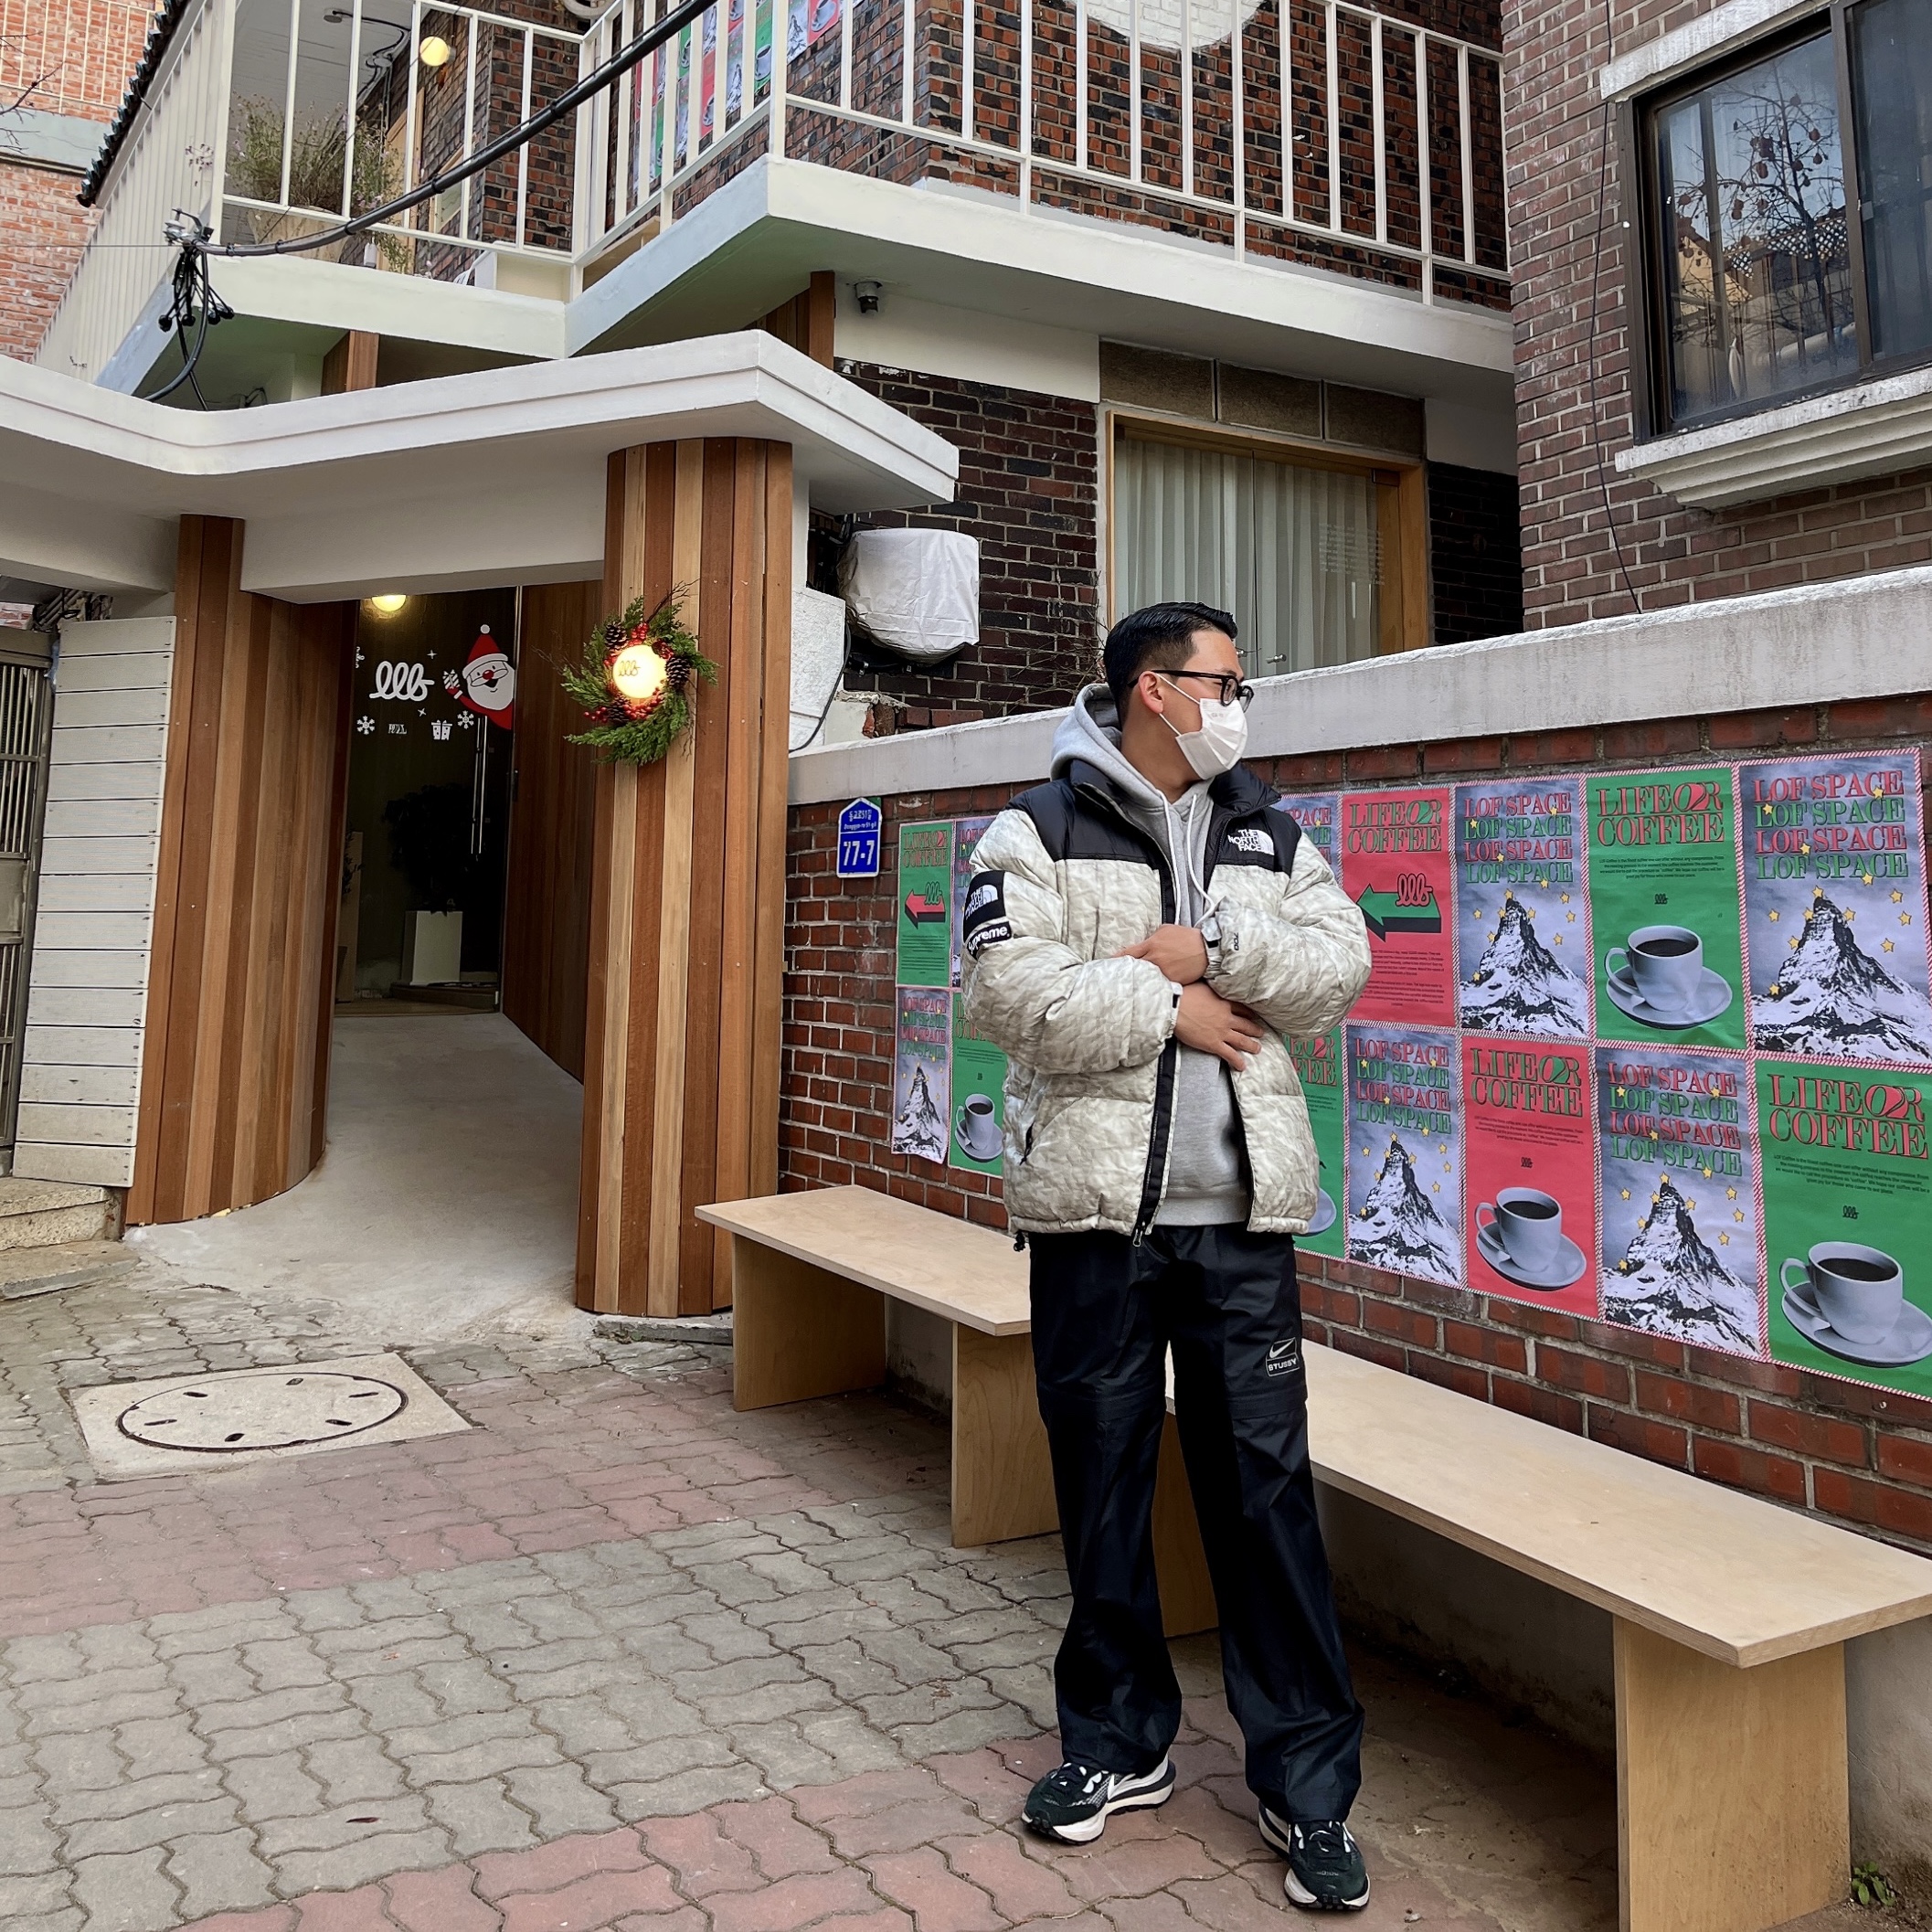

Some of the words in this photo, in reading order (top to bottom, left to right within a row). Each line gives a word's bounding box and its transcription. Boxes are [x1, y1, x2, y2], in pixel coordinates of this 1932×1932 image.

[1753, 777, 1806, 802] LOF
[1810, 770, 1904, 800] SPACE
[1284, 807, 1332, 826] PACE
[1464, 797, 1503, 818] LOF
[1506, 792, 1572, 816] SPACE
[1754, 801, 1808, 828] LOF
[1811, 798, 1905, 825] SPACE
[1347, 825, 1442, 854] COFFEE
[1463, 819, 1502, 840] LOF
[1505, 815, 1572, 838] SPACE
[1598, 812, 1725, 846] COFFEE
[1755, 829, 1809, 854] LOF
[1813, 825, 1906, 852] SPACE
[844, 840, 875, 865] 77-7
[1238, 844, 1261, 852] FACE
[1463, 840, 1503, 862] LOF
[1505, 838, 1573, 860] SPACE
[1464, 863, 1503, 884] LOF
[1506, 862, 1573, 883] SPACE
[1756, 855, 1810, 879] LOF
[1814, 853, 1908, 879] SPACE
[1355, 1037, 1388, 1060] LOF
[1391, 1042, 1449, 1067] SPACE
[1356, 1059, 1389, 1081] LOF
[1392, 1063, 1449, 1089] SPACE
[1608, 1062, 1653, 1088] LOF
[1657, 1067, 1737, 1097] SPACE
[1356, 1080, 1389, 1102] LOF
[1392, 1084, 1450, 1111] SPACE
[1471, 1077, 1583, 1118] COFFEE
[1608, 1087, 1654, 1112] LOF
[1658, 1092, 1738, 1123] SPACE
[1356, 1101, 1390, 1124] LOF
[1393, 1106, 1451, 1134] SPACE
[1609, 1110, 1655, 1137] LOF
[1660, 1117, 1741, 1150] SPACE
[1769, 1108, 1928, 1159] COFFEE
[1610, 1135, 1658, 1162] LOF
[1662, 1142, 1742, 1176] SPACE
